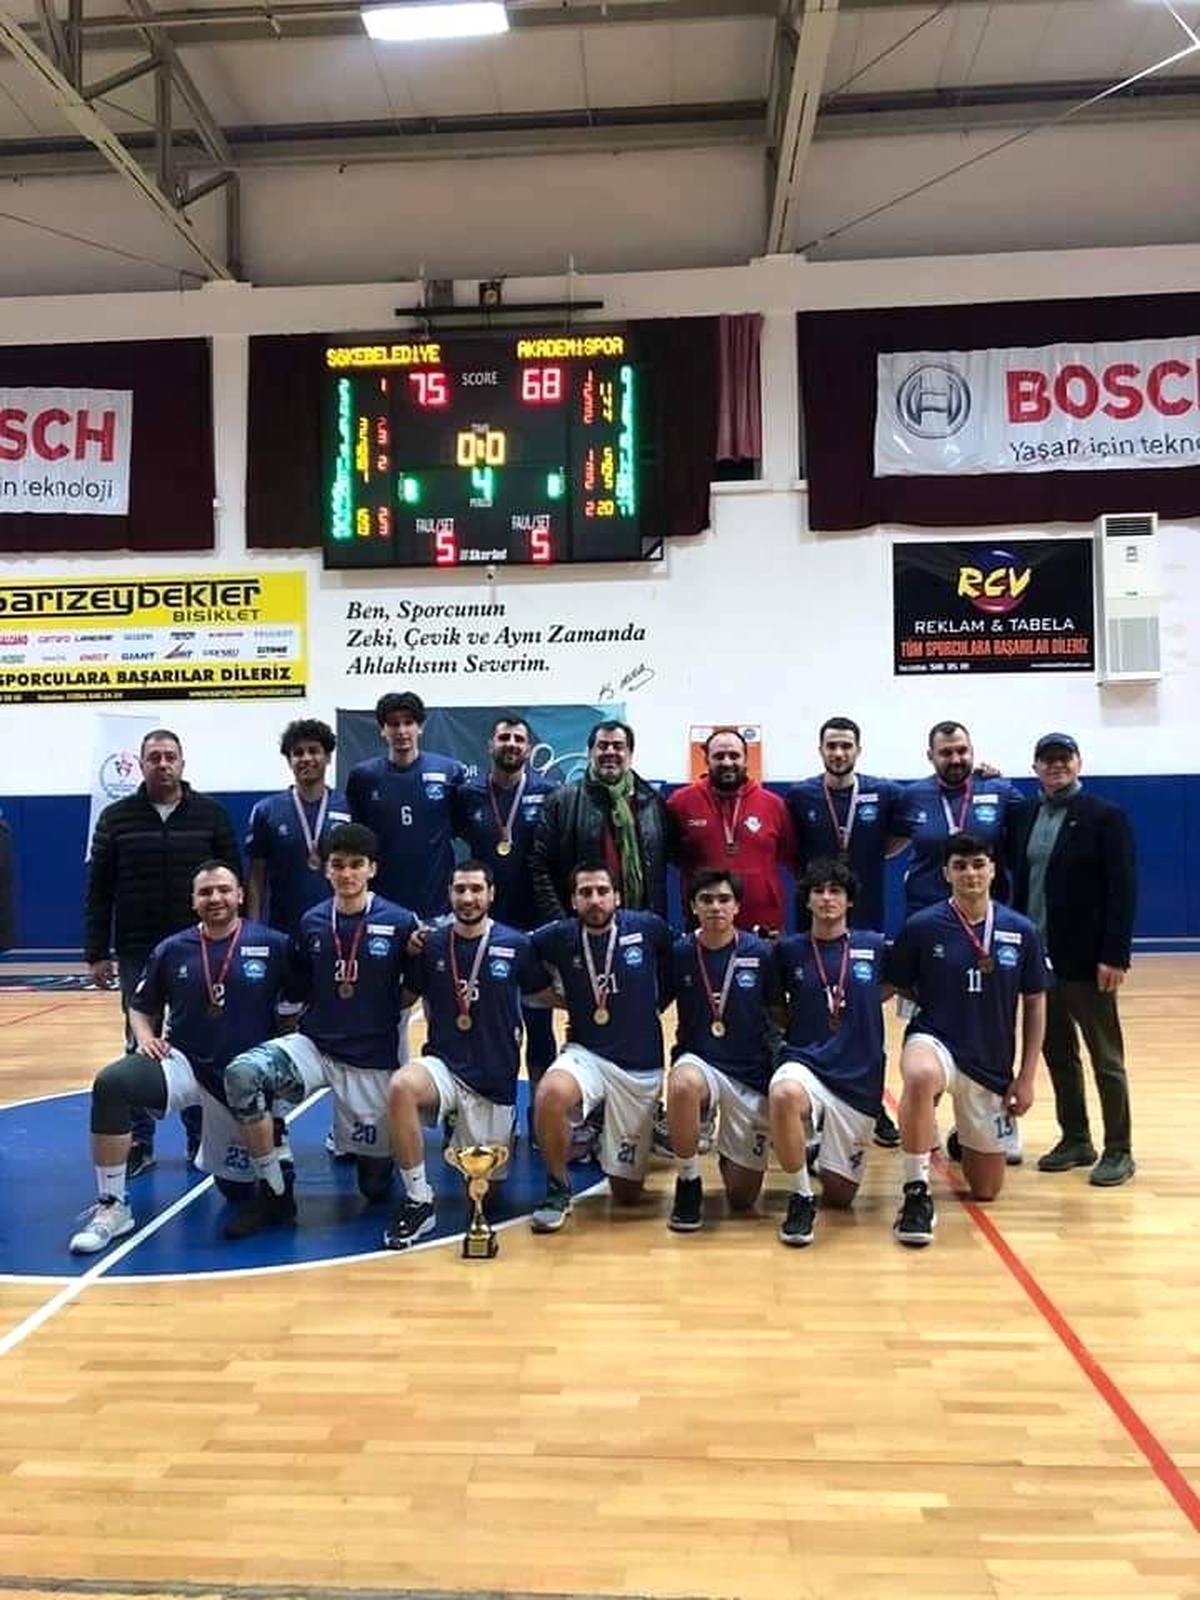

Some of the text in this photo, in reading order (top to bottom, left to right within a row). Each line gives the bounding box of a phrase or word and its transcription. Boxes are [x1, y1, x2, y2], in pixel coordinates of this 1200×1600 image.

[409, 372, 446, 405] 75
[461, 371, 498, 386] SCORE
[523, 367, 560, 400] 68
[1006, 358, 1200, 423] BOSC
[0, 408, 115, 462] SCH
[1090, 437, 1133, 458] için
[472, 466, 493, 499] 4
[436, 531, 455, 563] 5
[531, 529, 549, 560] 5
[957, 566, 1032, 600] RCV
[346, 600, 506, 623] Ben, Sporcunun
[346, 622, 646, 651] Zeki, Çevik ve Aynı Zamanda
[914, 617, 1076, 635] REKLAM & TABELA
[121, 651, 157, 661] GIANT
[900, 636, 922, 658] TÜM
[924, 637, 990, 658] SPORCULARA
[117, 668, 214, 688] BAŞARILAR
[221, 663, 291, 681] DİLERİZ
[464, 653, 550, 674] Severim.
[401, 805, 413, 826] 6
[966, 967, 983, 992] 11
[352, 1121, 376, 1145] 20
[617, 1142, 637, 1165] 21
